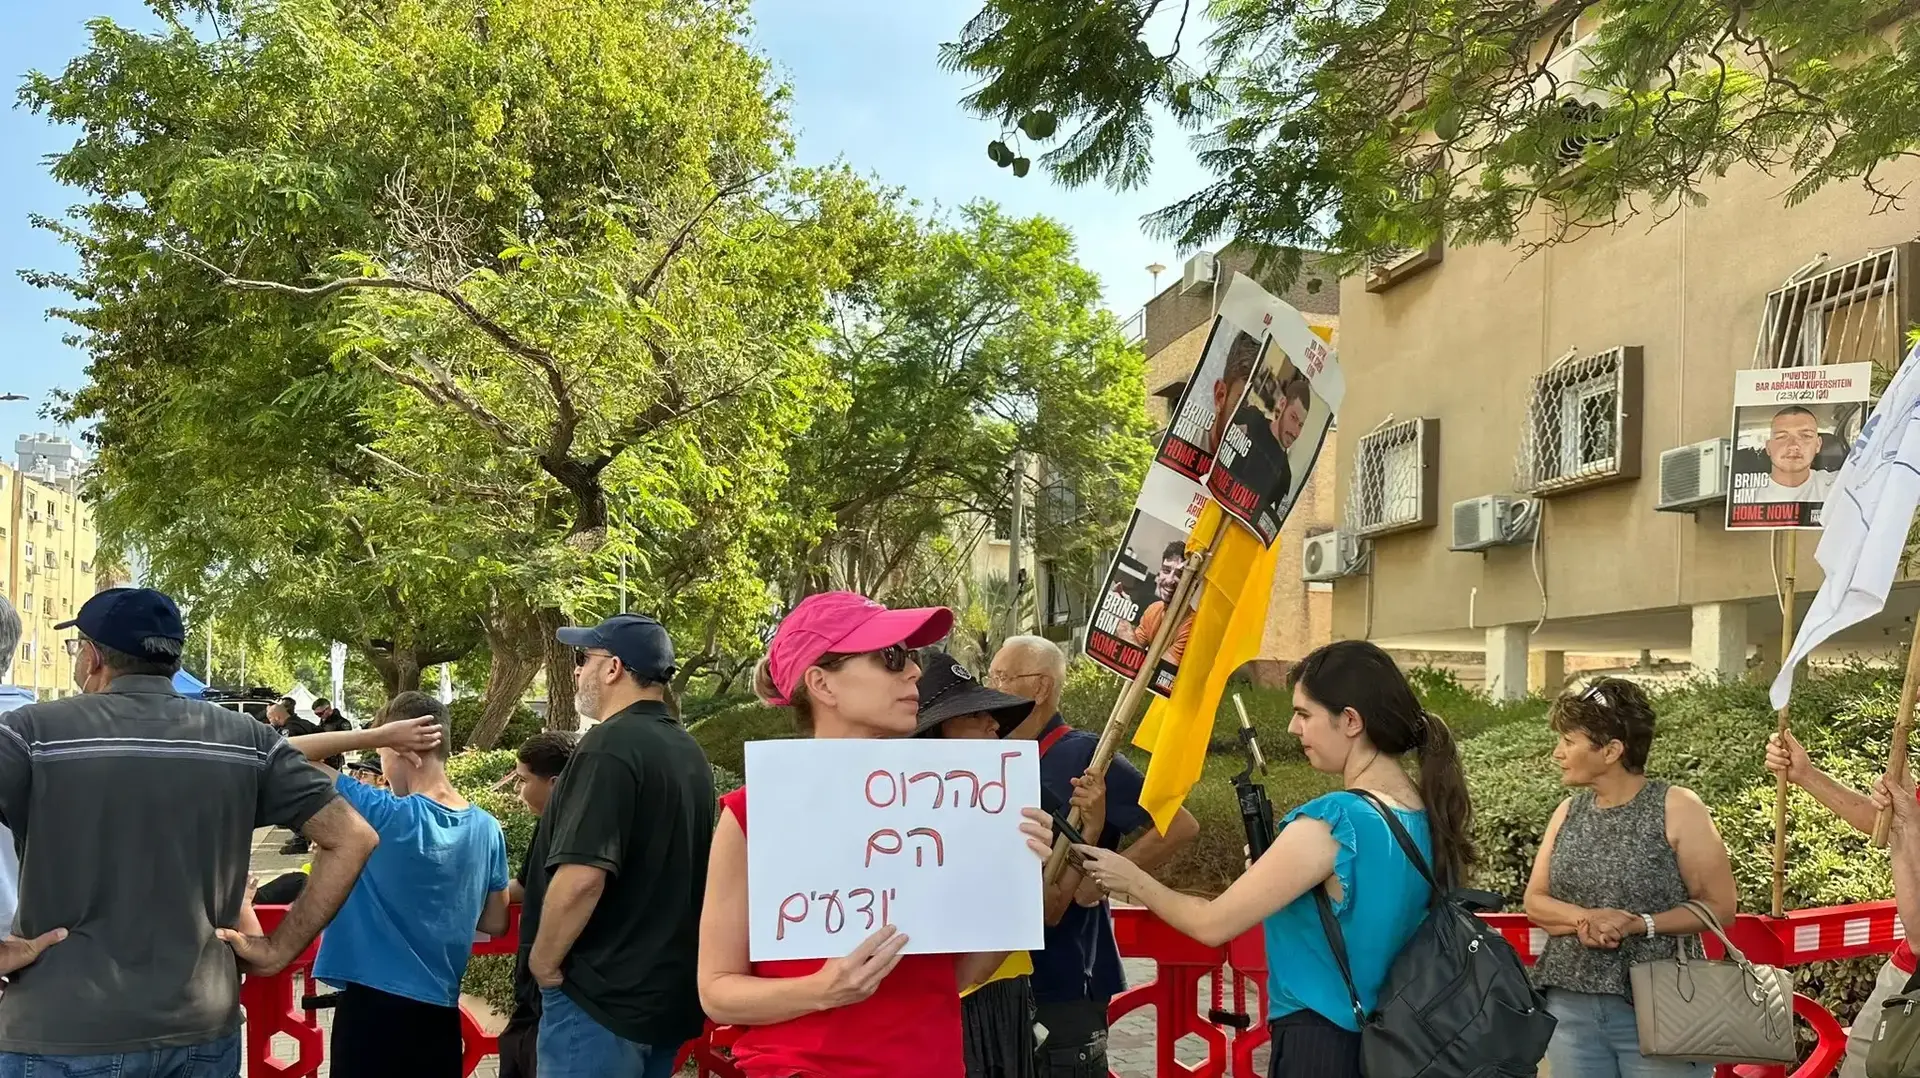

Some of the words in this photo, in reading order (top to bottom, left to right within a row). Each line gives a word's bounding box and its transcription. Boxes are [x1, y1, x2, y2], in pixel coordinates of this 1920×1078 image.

[1755, 382, 1770, 391] BAR
[1770, 380, 1805, 391] ABRAHAM
[1806, 378, 1852, 390] KUPERSHTEIN
[1172, 416, 1199, 443] HIM
[1180, 400, 1216, 431] BRING
[1164, 437, 1198, 468] HOME
[1219, 440, 1237, 469] HIM
[1225, 422, 1252, 458] BRING
[1734, 472, 1770, 489] BRING
[1229, 481, 1260, 514] NOW!
[1733, 488, 1755, 504] HIM
[1184, 517, 1197, 529] (2
[1732, 504, 1764, 521] HOME
[1766, 503, 1800, 520] NOW!
[1102, 590, 1139, 622] BRING
[1095, 609, 1120, 635] HIM
[1089, 630, 1121, 660] HOME
[865, 751, 1022, 814] להרוס
[865, 827, 944, 868] הם
[775, 888, 896, 941] יודעים
